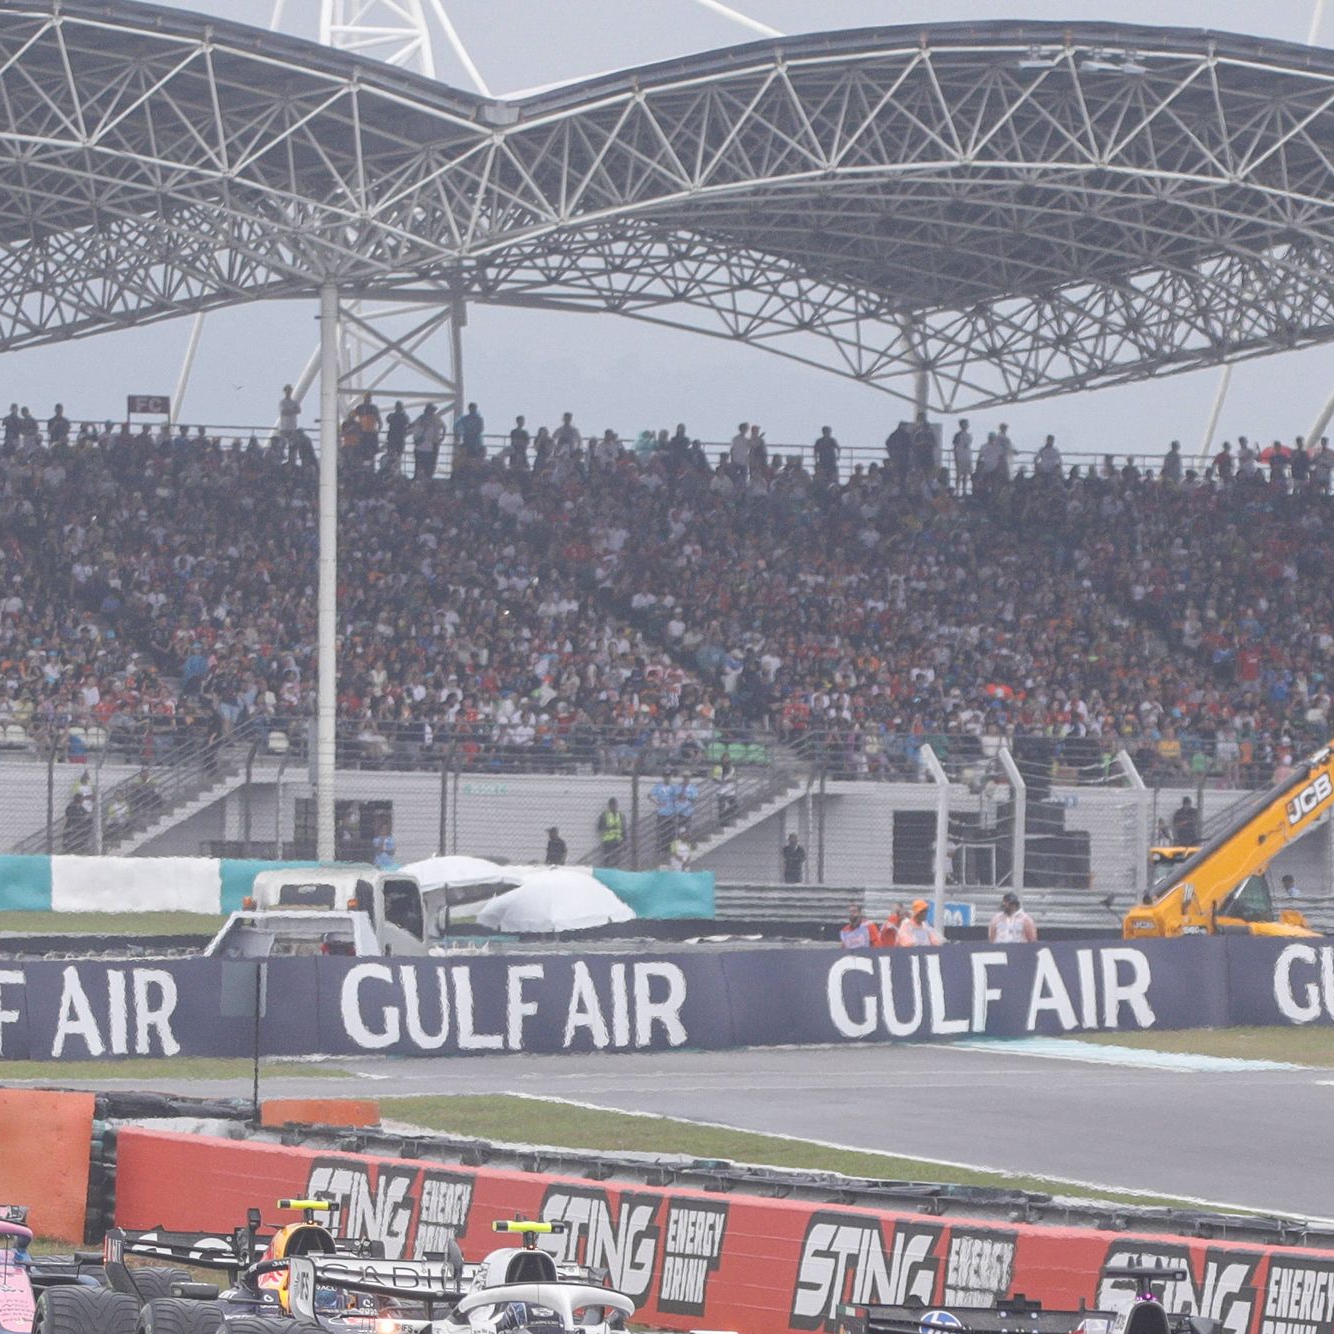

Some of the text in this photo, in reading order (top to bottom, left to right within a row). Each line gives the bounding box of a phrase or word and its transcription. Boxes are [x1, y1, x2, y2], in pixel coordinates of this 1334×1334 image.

[136, 397, 164, 411] FC
[1288, 772, 1333, 825] JCB
[52, 966, 180, 1057] AIR
[341, 961, 687, 1049] GULF AIR
[827, 948, 1155, 1038] GULF AIR
[308, 1167, 411, 1259] STING
[536, 1193, 656, 1296] STING
[666, 1207, 726, 1257] ENERGY
[660, 1256, 708, 1304] DRINK
[794, 1223, 934, 1320] STING
